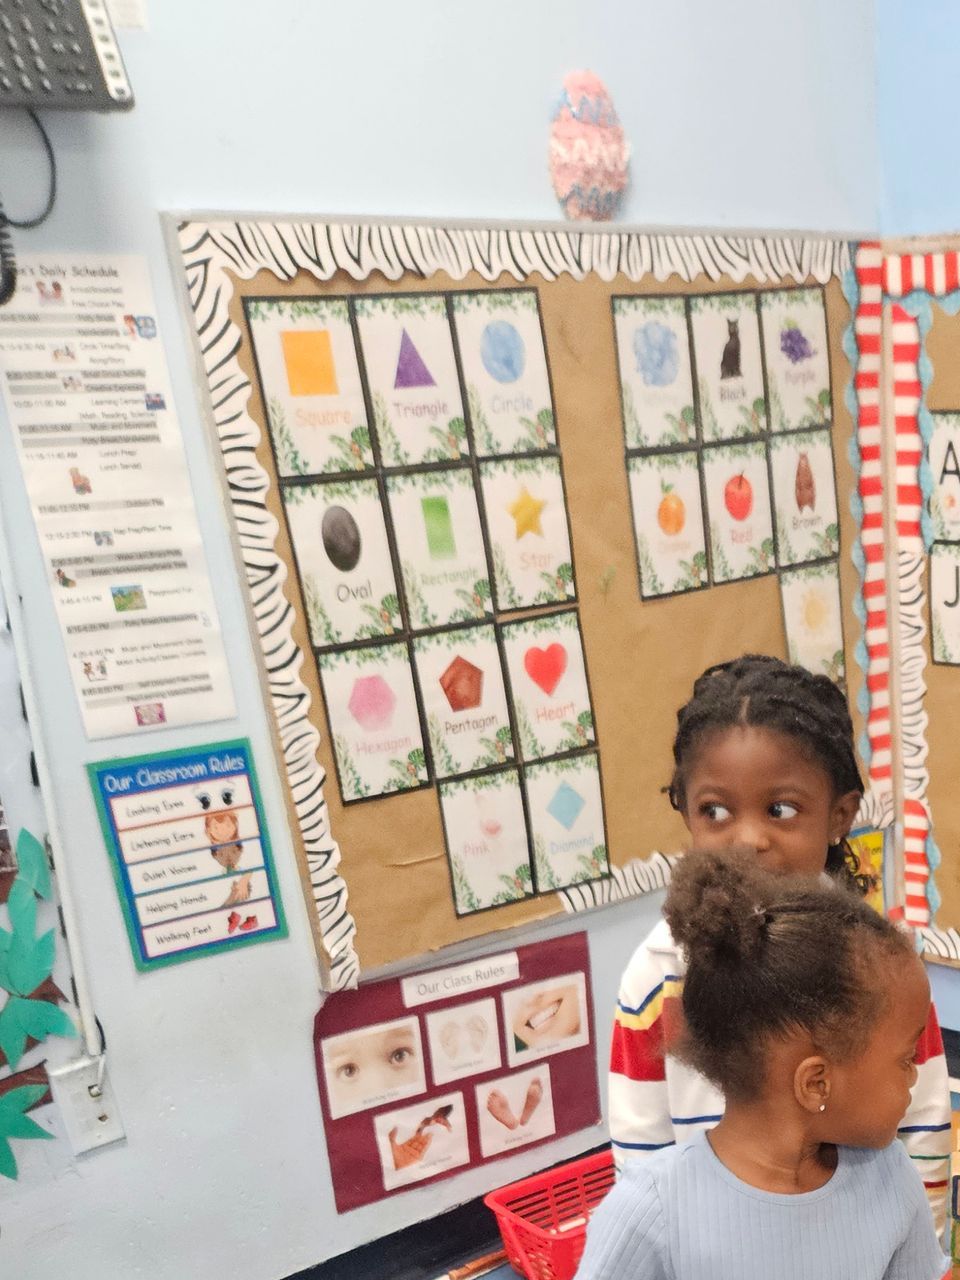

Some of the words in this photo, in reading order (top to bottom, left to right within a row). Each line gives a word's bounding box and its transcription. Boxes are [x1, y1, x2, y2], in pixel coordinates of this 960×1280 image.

[394, 400, 449, 420] Triangle
[336, 580, 373, 603] Oval
[536, 700, 577, 722] Heart
[444, 713, 498, 735] Pentagon
[355, 735, 412, 756] Hexagon
[103, 773, 133, 793] Our
[135, 763, 208, 786] Classroom
[208, 754, 246, 773] Rules
[155, 930, 191, 945] Walking
[416, 979, 441, 997] Our
[443, 973, 474, 991] Class
[474, 964, 506, 982] Rules
